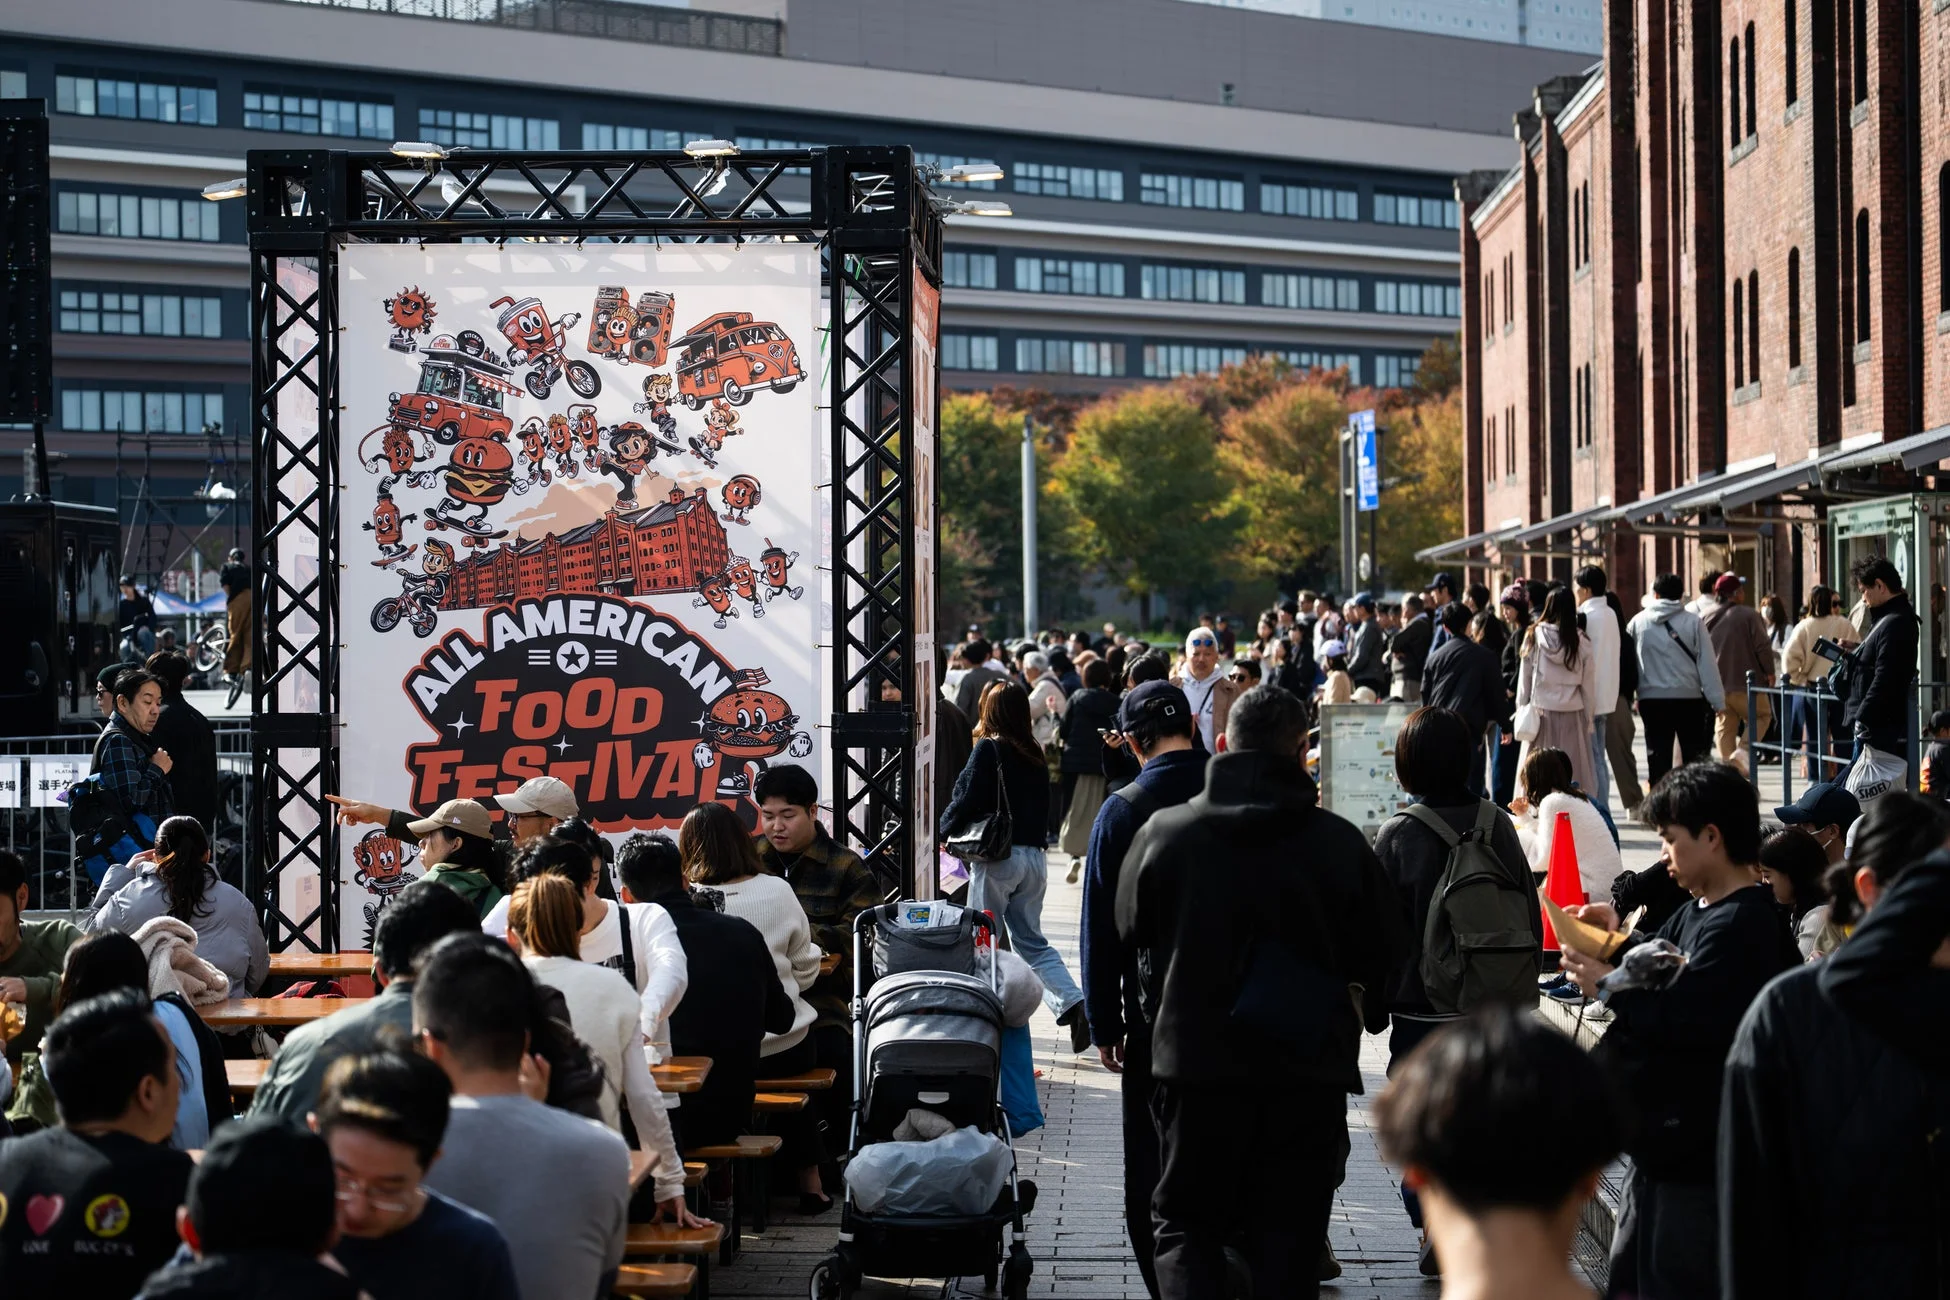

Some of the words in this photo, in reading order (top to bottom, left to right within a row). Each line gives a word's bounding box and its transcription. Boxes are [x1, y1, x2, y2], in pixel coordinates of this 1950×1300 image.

[411, 636, 486, 714] ALL
[492, 599, 732, 705] AMERICAN
[475, 678, 663, 740] FOOD
[414, 739, 737, 822] FESTIVAL
[1858, 782, 1887, 799] SHOEI
